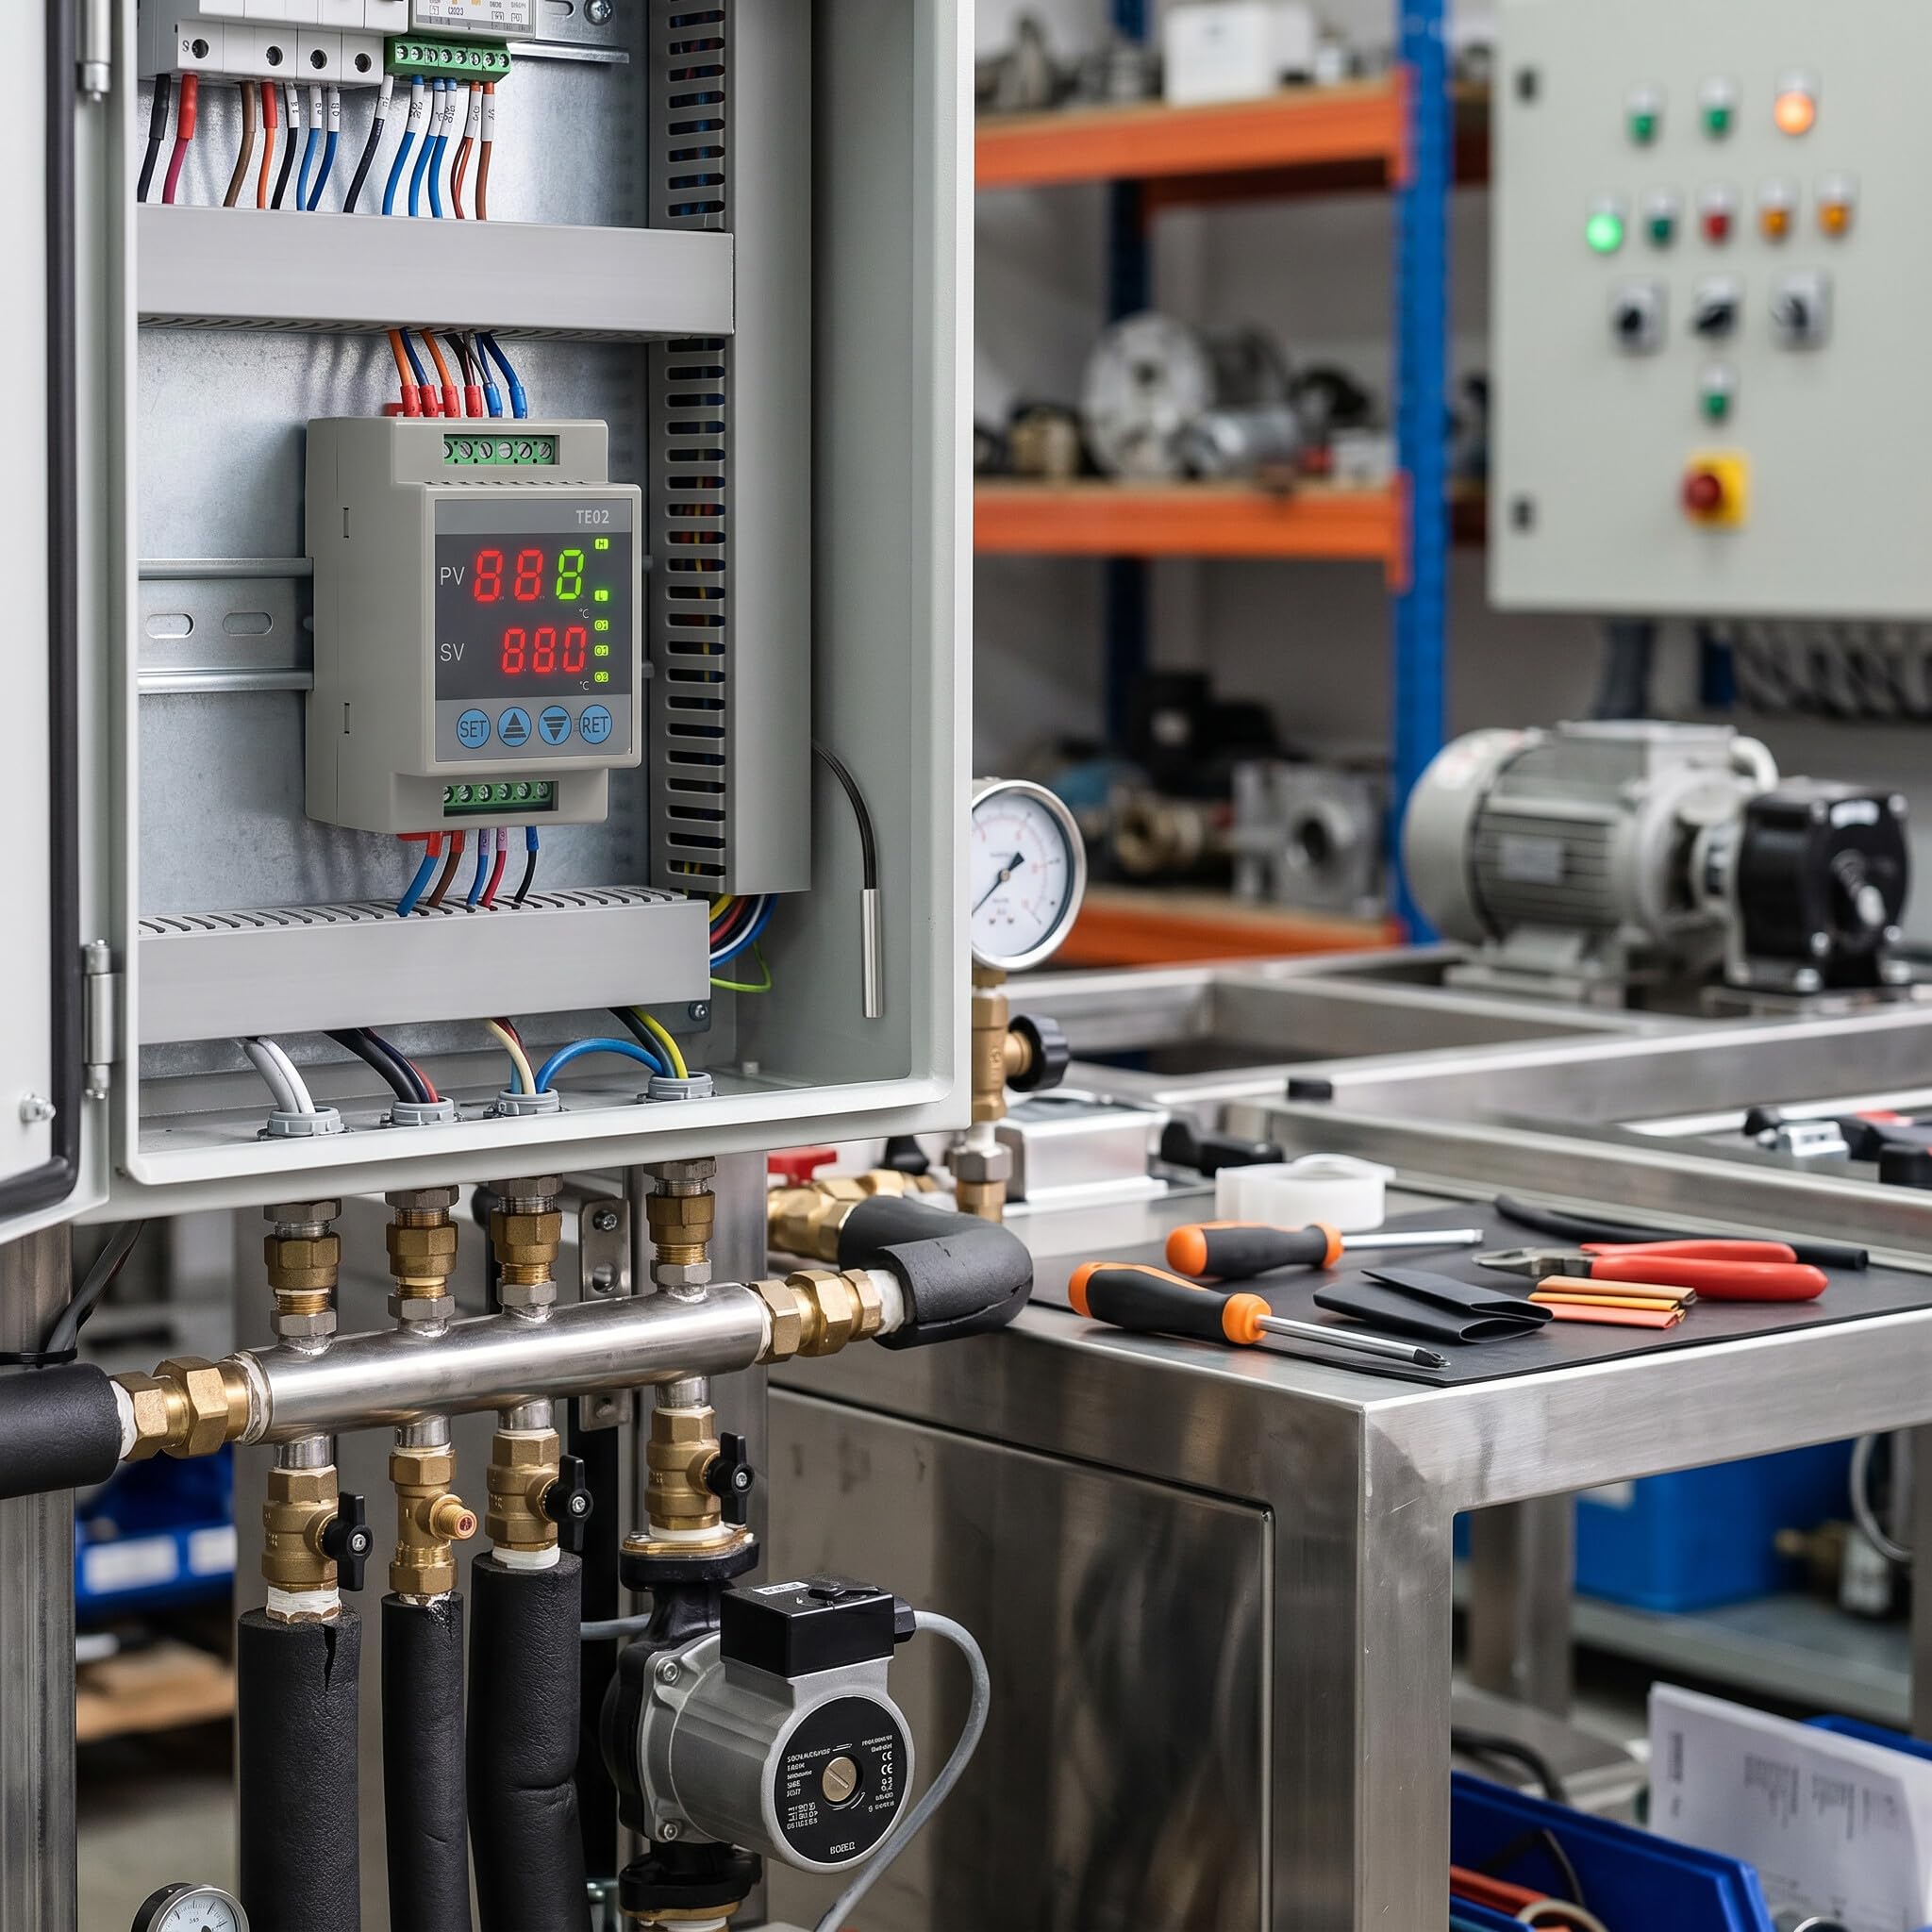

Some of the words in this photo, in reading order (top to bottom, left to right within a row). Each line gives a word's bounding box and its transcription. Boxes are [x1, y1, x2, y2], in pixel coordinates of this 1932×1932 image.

[576, 509, 610, 525] TE02
[440, 566, 465, 586] PV
[440, 642, 465, 662] SV
[502, 626, 587, 674] 880
[459, 720, 487, 738] SET
[582, 716, 608, 734] RET
[881, 1751, 893, 1762] CE
[881, 1762, 893, 1775] CE
